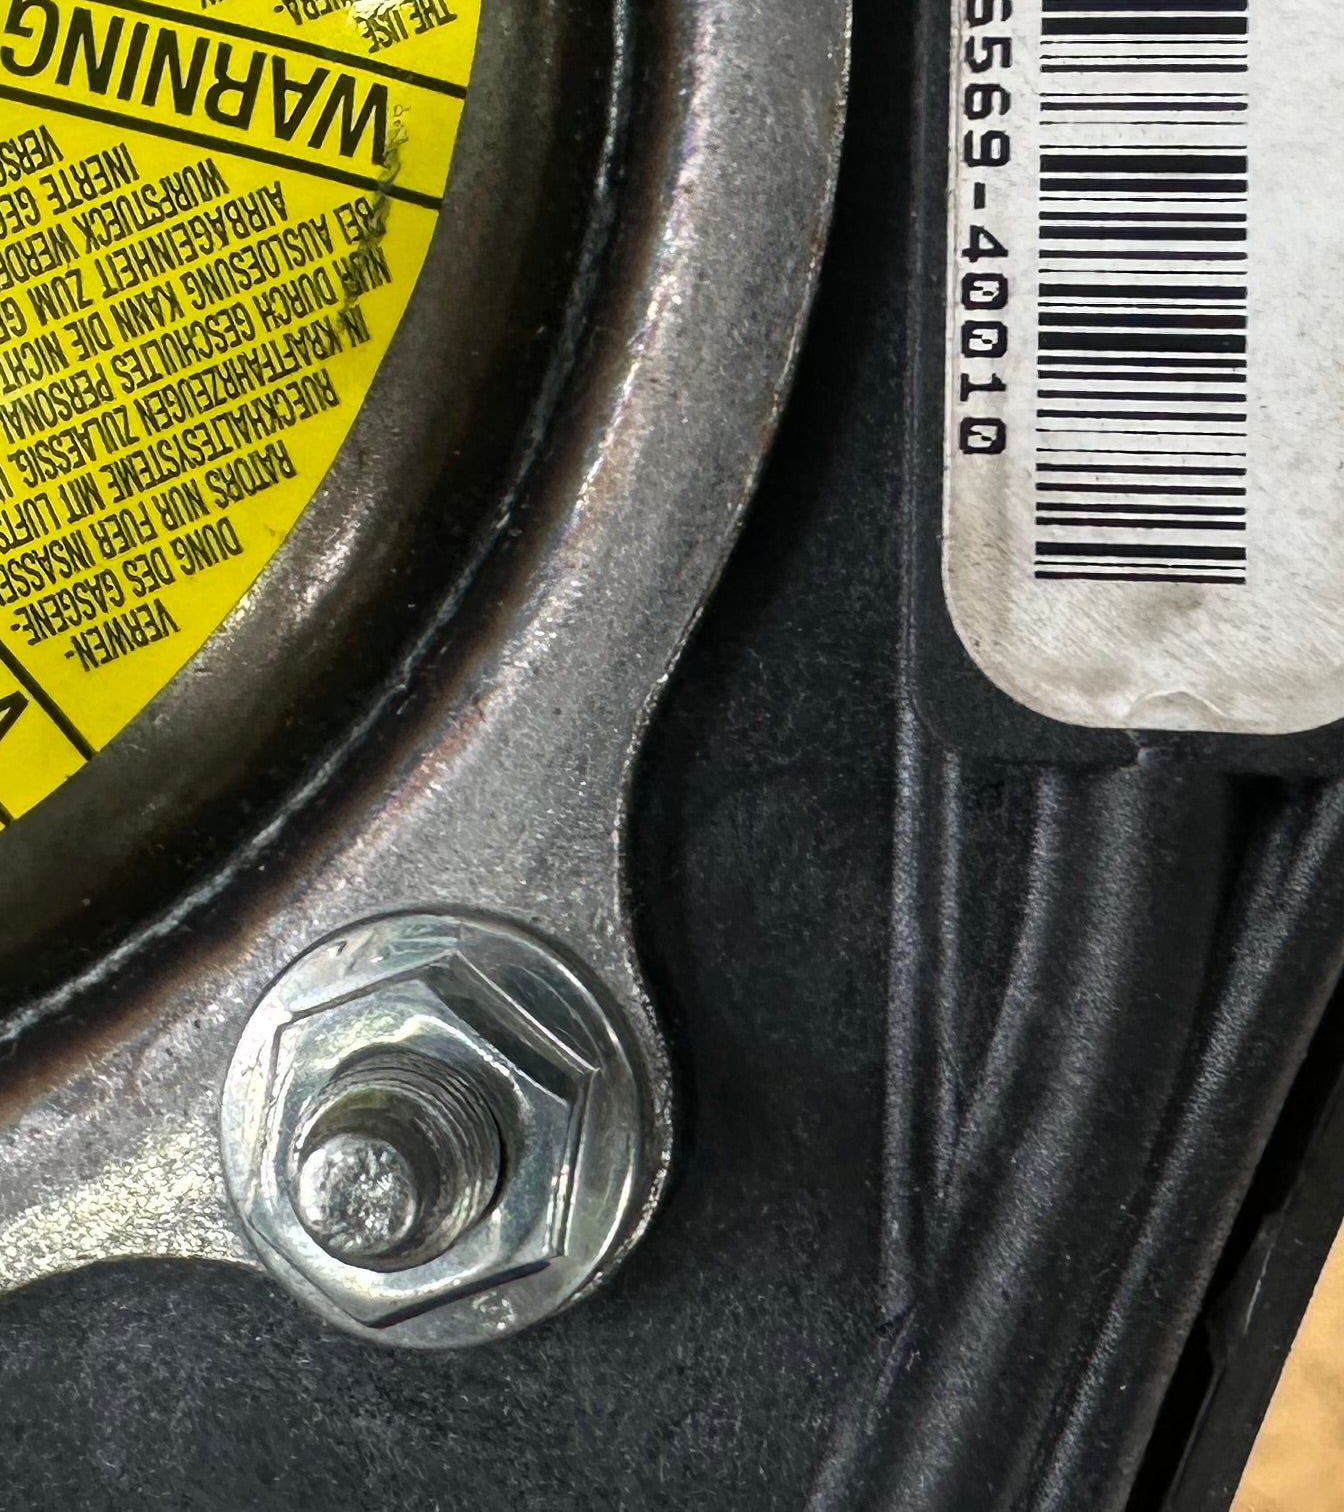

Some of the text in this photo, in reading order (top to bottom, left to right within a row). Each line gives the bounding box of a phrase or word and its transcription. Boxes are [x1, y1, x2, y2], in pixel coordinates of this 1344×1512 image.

[38, 142, 140, 216] INERTE
[71, 157, 230, 255] WURFSTUECK
[26, 180, 288, 327] AIRBAGEINHEIT ZUM
[179, 213, 334, 311] AUSLOESUNG
[63, 311, 115, 362] DIE
[109, 280, 185, 343] KANN
[251, 266, 339, 333] DURCH
[110, 301, 256, 394] GESCHULTES
[132, 315, 344, 437] KRAFTFAHRZEUGEN
[98, 367, 341, 504] RUECKHALTESYSTEME
[57, 471, 106, 525] MIT
[150, 478, 211, 532] NUR
[204, 439, 298, 510] RATORS
[87, 500, 159, 560] FUER
[10, 516, 244, 646] DUNG DES GASGENE-
[63, 597, 181, 673] VERWEN-
